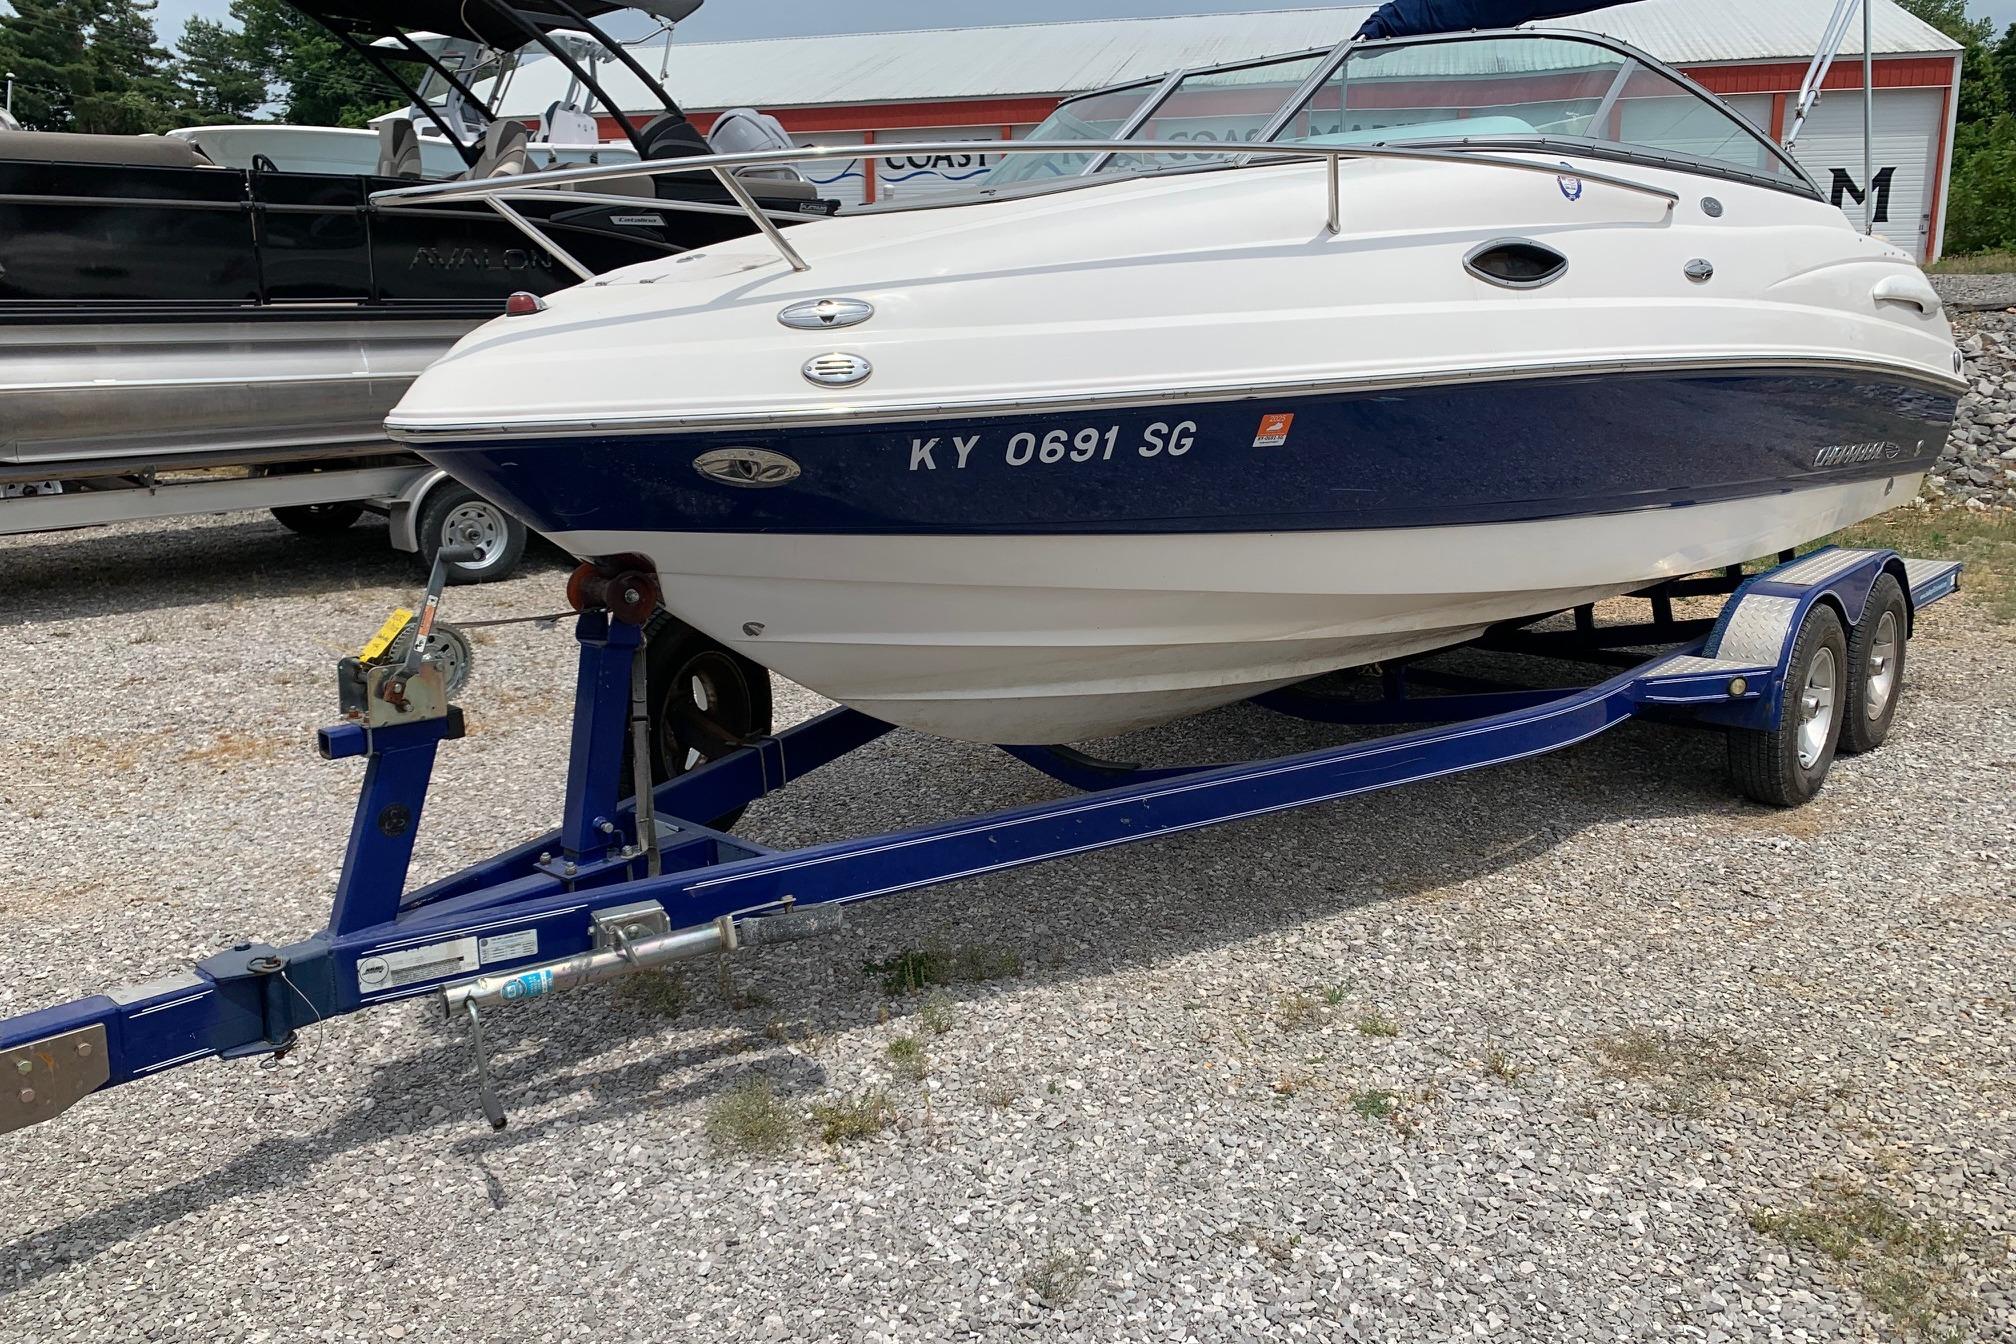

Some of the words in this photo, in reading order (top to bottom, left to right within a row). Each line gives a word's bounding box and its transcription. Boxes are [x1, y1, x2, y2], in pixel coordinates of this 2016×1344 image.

[1828, 166, 1897, 223] M
[408, 247, 552, 271] AVALON
[1005, 425, 1120, 466] 0691
[1138, 420, 1198, 458] SG
